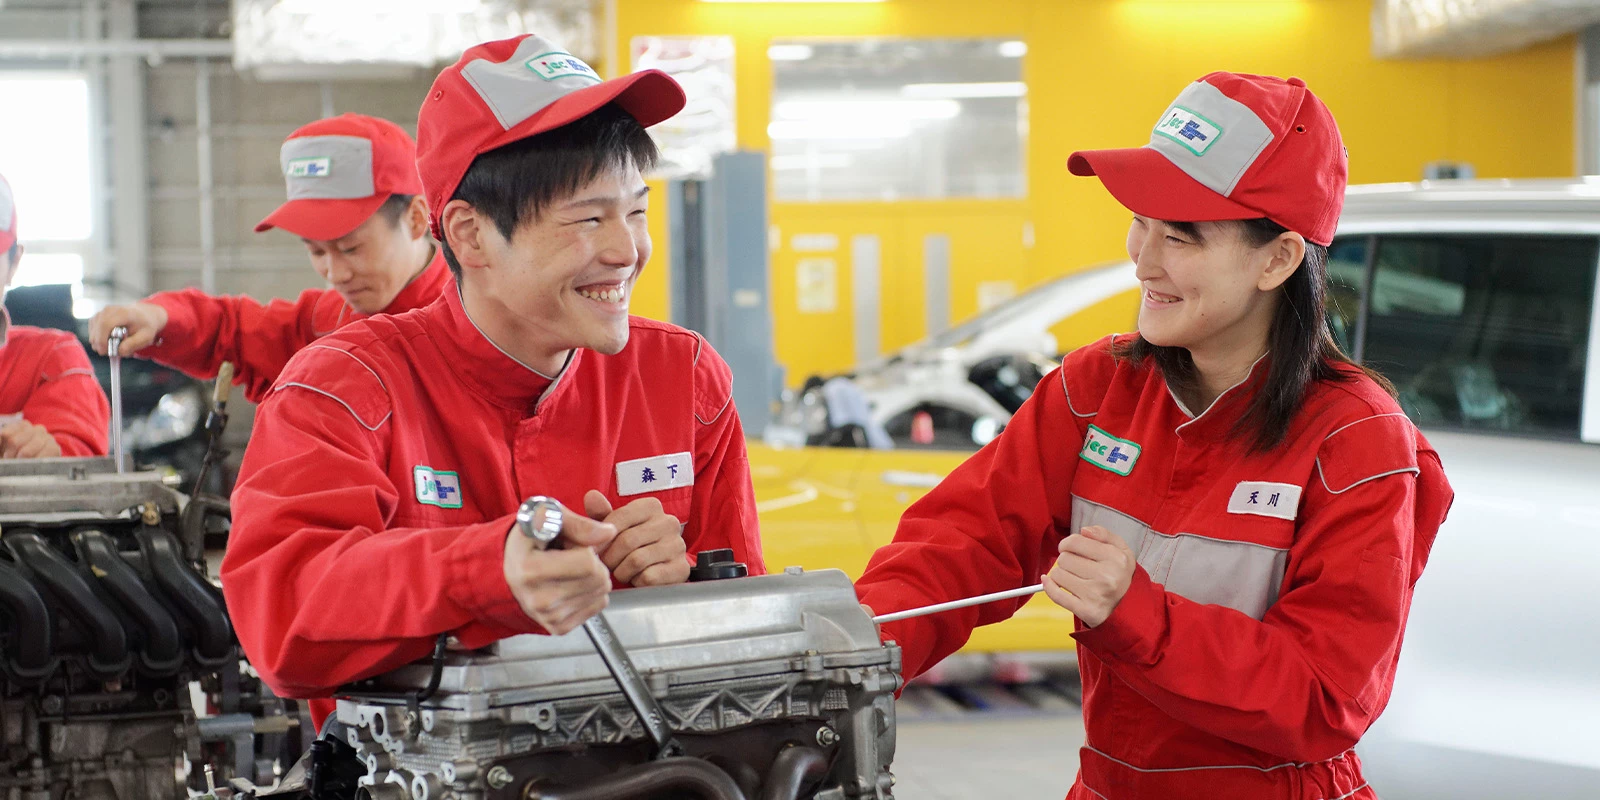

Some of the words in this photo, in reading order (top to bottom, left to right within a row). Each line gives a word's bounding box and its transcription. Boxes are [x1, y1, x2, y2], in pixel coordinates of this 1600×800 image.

[541, 61, 568, 74] jec
[1161, 113, 1184, 130] jec
[1083, 435, 1108, 456] jec
[641, 464, 678, 483] 森下
[1247, 491, 1280, 507] 天川
